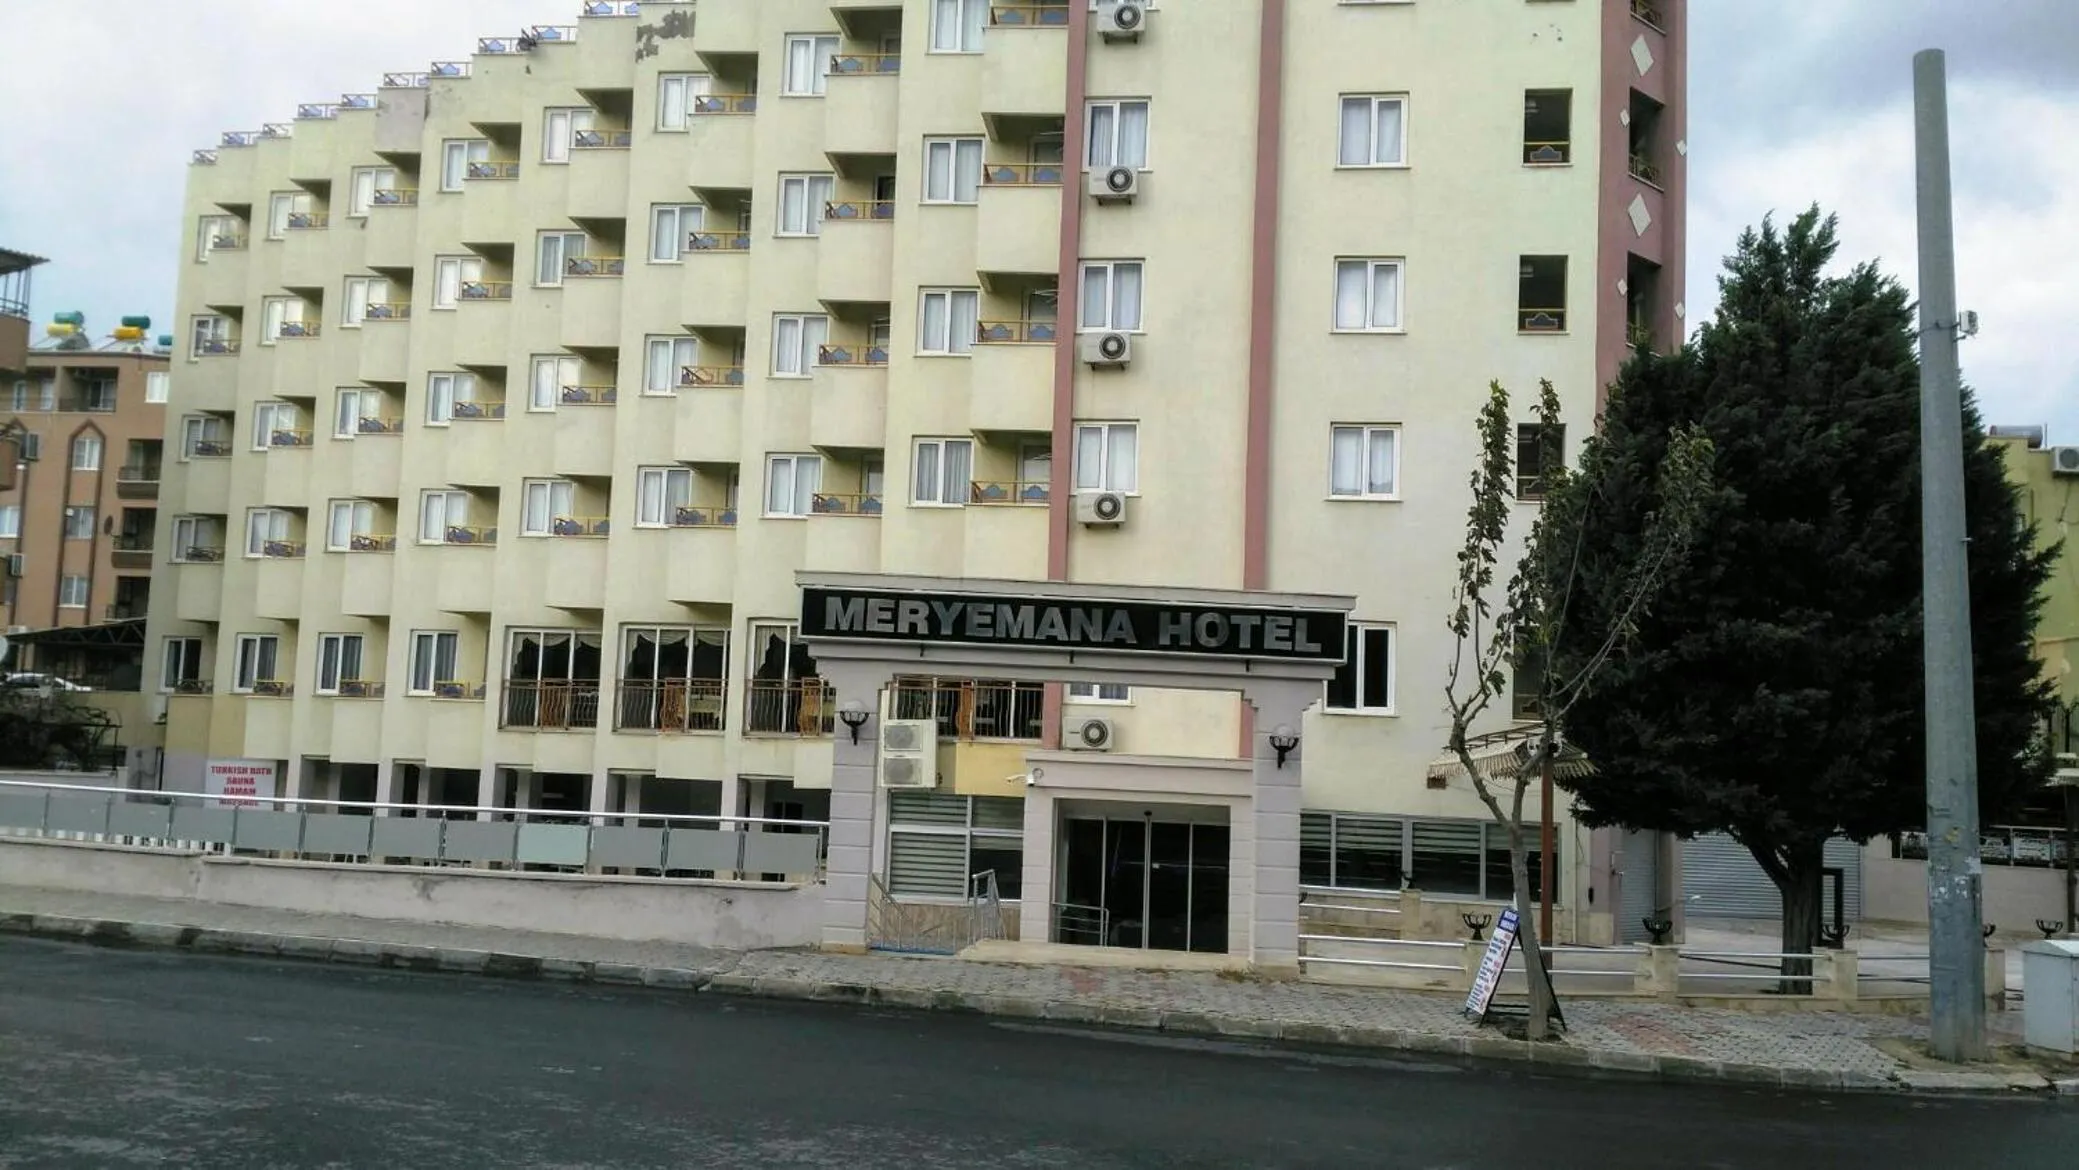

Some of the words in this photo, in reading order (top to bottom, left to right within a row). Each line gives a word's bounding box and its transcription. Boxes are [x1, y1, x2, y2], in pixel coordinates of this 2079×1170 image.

[824, 596, 1138, 645] MERYEMANA
[1158, 611, 1322, 653] HOTEL
[210, 766, 248, 774] TURKISH
[226, 777, 255, 785] SAUNA
